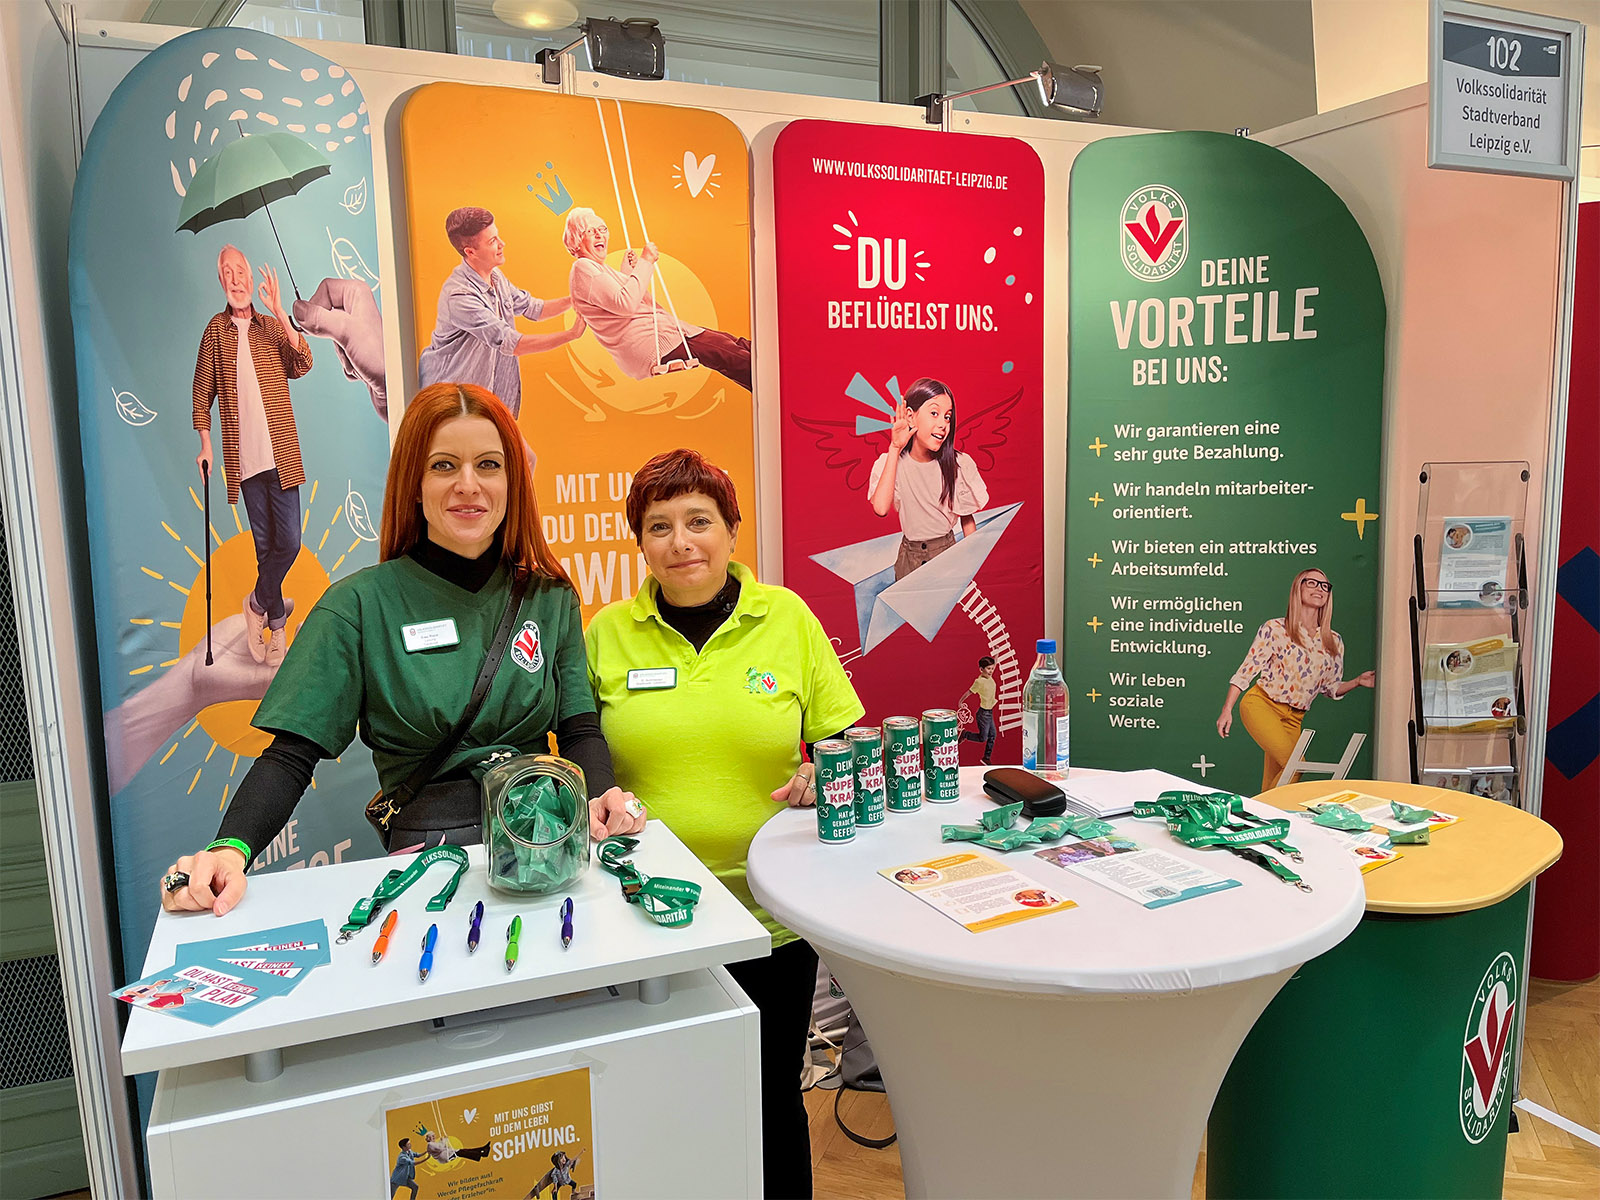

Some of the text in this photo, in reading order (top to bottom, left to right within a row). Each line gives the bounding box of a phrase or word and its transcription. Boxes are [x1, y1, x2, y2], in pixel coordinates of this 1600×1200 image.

[1486, 36, 1522, 72] 102
[1456, 77, 1547, 105] Volkssolidarität
[1462, 105, 1540, 130] Stadtverband
[1470, 133, 1532, 156] Leipzig e.V.
[812, 157, 1008, 190] WWW.VOLKSSOLIDARITAET-LEIPZIG.DE
[1129, 190, 1178, 212] VOLKS
[858, 236, 906, 290] DU
[1126, 240, 1183, 277] SOLIDARITÄT
[1201, 255, 1270, 288] DEINE
[828, 296, 998, 332] BEFLÜGELST UNS.
[1109, 287, 1320, 350] VORTEILE
[1132, 355, 1228, 386] BEI UNS:
[1114, 421, 1280, 441] Wir garantieren eine
[1114, 444, 1284, 464] sehr gute Bezahlung.
[555, 472, 635, 504] MIT UN
[1113, 480, 1314, 497] Wir handeln mitarbeiter-
[1112, 505, 1192, 520] orientiert.
[542, 512, 635, 545] DU DEM
[1112, 540, 1318, 555] Wir bieten ein attraktives
[1111, 562, 1228, 577] Arbeitsumfeld.
[1111, 596, 1242, 615] Wir ermöglichen
[1110, 618, 1244, 634] eine individuelle
[1110, 639, 1212, 658] Entwicklung.
[1110, 672, 1186, 688] Wir leben
[1110, 694, 1164, 708] soziale
[1109, 715, 1160, 730] Werte.
[896, 752, 920, 764] SUPE
[934, 744, 958, 756] SUPE
[900, 764, 920, 776] KRA
[938, 756, 959, 766] KRA
[908, 782, 917, 790] HAT
[944, 773, 954, 781] HAT
[902, 796, 921, 808] GEFE
[940, 788, 959, 798] GEFE
[838, 811, 848, 820] HAT
[254, 819, 300, 871] INE
[183, 968, 233, 988] DU HAST
[1478, 961, 1512, 1003] VOLKS
[200, 988, 246, 1006] PLAN
[1464, 1050, 1510, 1137] SOLIDARITÄT
[494, 1100, 554, 1124] MIT UNS GIBST
[490, 1114, 549, 1138] DU DEM LEBEN
[492, 1124, 580, 1162] SCHWUNG.
